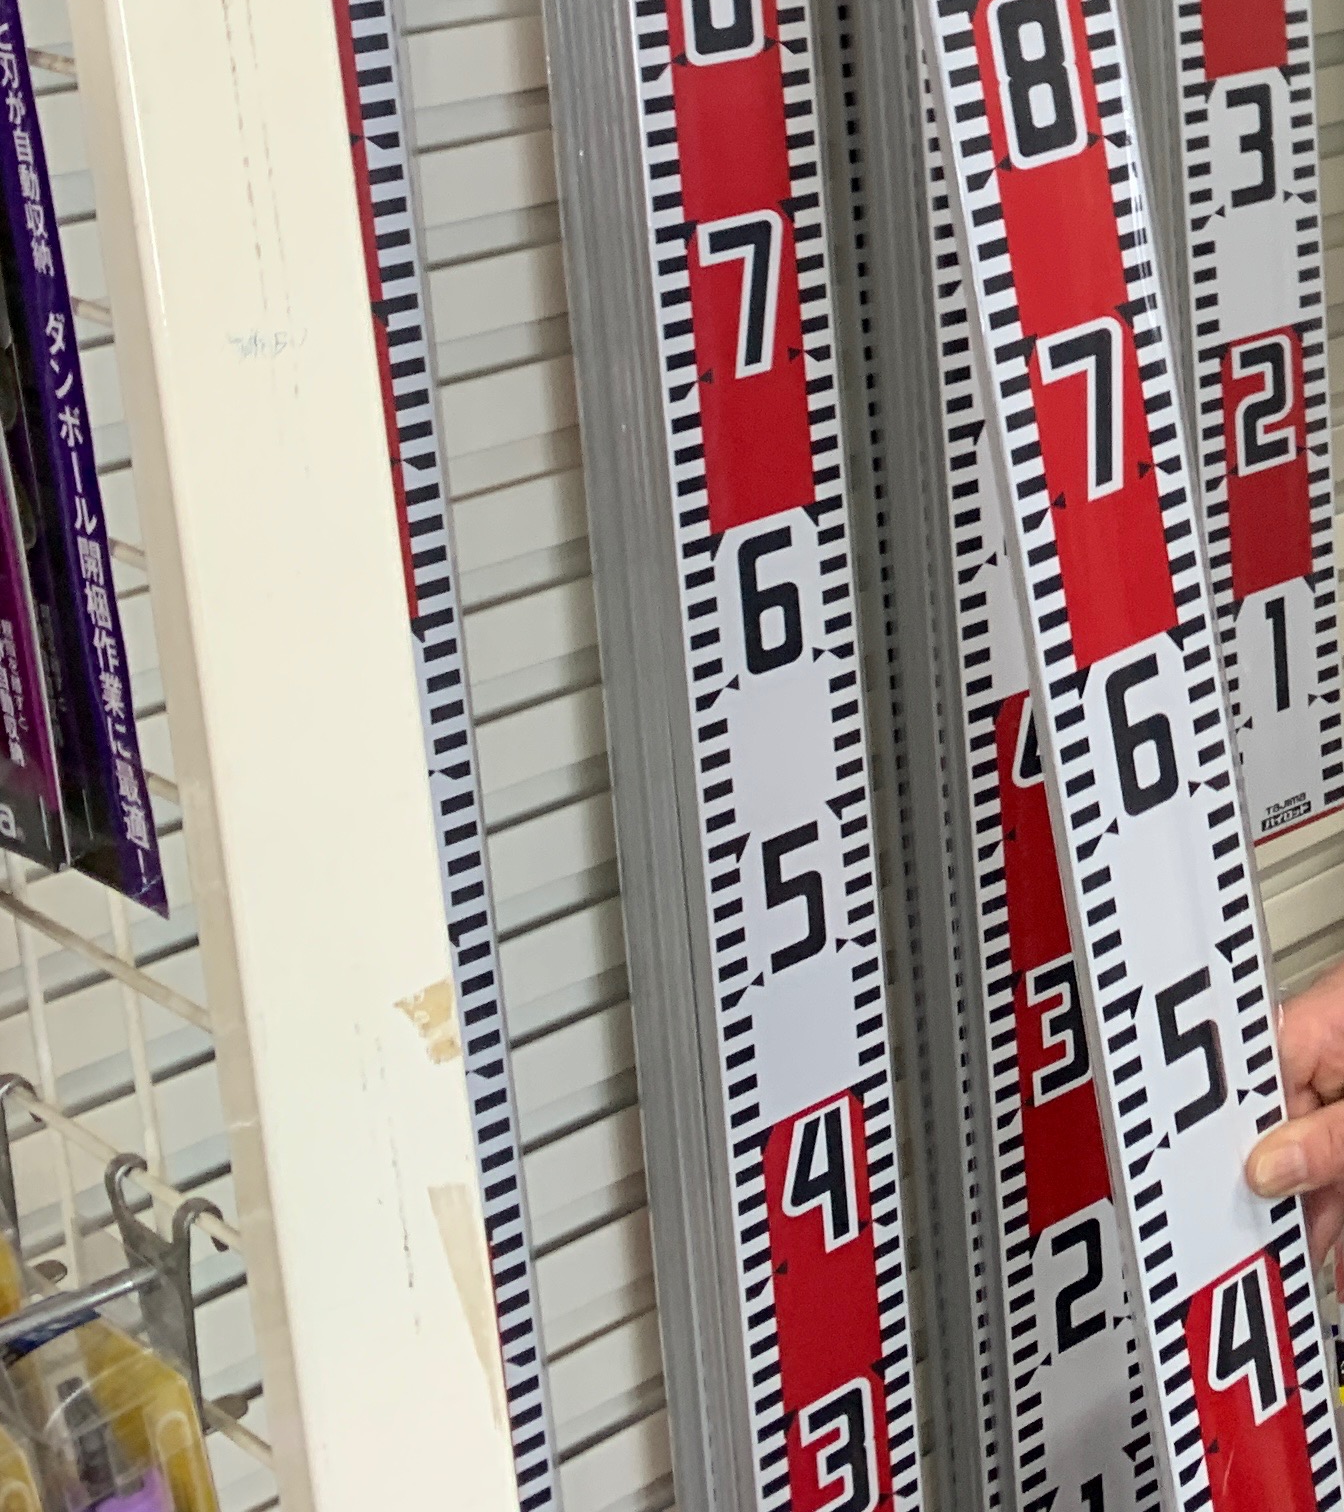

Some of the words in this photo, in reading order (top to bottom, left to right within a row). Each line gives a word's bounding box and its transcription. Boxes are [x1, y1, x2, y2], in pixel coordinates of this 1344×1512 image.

[1226, 83, 1277, 208] 3
[696, 209, 783, 379] 7
[1036, 316, 1124, 502] 7
[1231, 334, 1296, 477] 2
[737, 525, 803, 675] 6
[1265, 597, 1290, 712] 1
[1105, 653, 1180, 818] 6
[760, 819, 828, 974] 5
[1025, 952, 1093, 1108] 3
[1153, 965, 1227, 1134] 5
[782, 1097, 860, 1254] 4
[1050, 1217, 1107, 1355] 2
[1208, 1257, 1290, 1426] 4
[799, 1377, 880, 1512] 3
